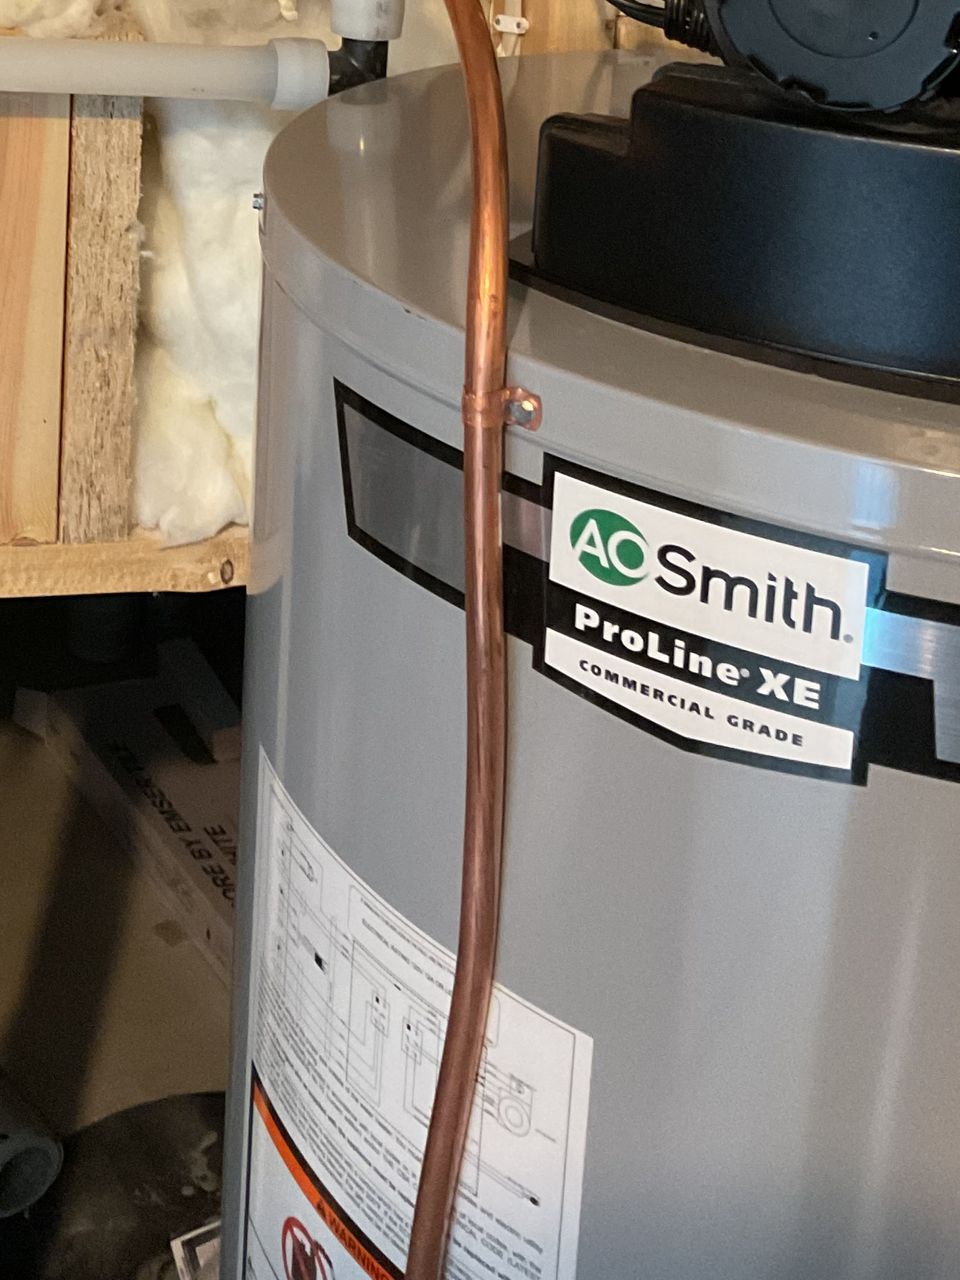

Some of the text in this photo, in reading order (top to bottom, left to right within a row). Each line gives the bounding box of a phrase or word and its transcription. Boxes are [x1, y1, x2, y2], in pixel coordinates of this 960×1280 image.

[578, 658, 805, 748] COMMERCIAL GRADE
[755, 666, 822, 711] XE
